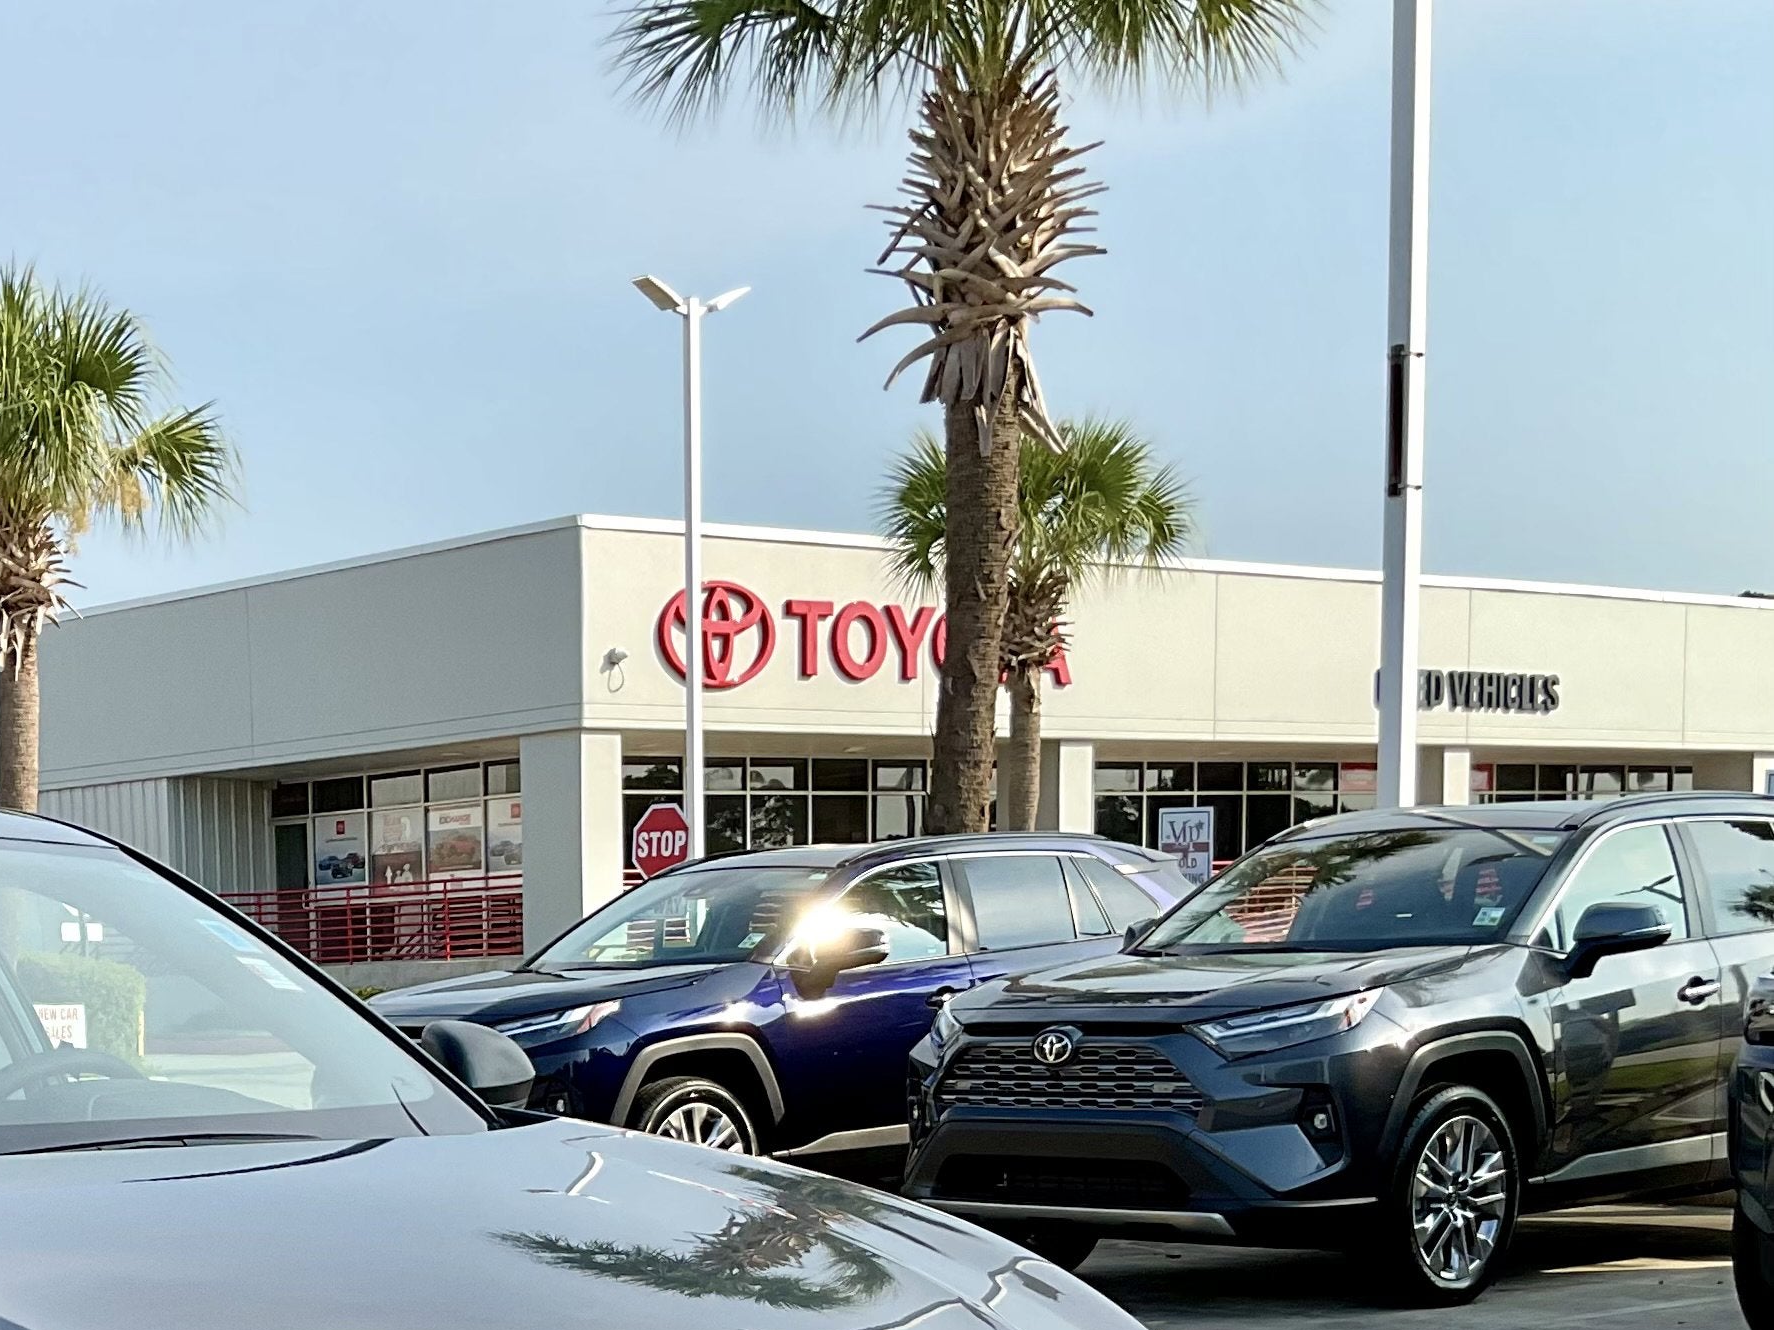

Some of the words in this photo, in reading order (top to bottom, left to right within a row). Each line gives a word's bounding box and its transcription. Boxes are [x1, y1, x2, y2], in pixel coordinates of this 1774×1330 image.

[784, 599, 1072, 686] TOY
[1373, 669, 1445, 711] ED
[1445, 670, 1560, 715] VEHICLES
[637, 830, 687, 858] STOP
[1178, 857, 1197, 868] OLD
[60, 1007, 78, 1020] CAR
